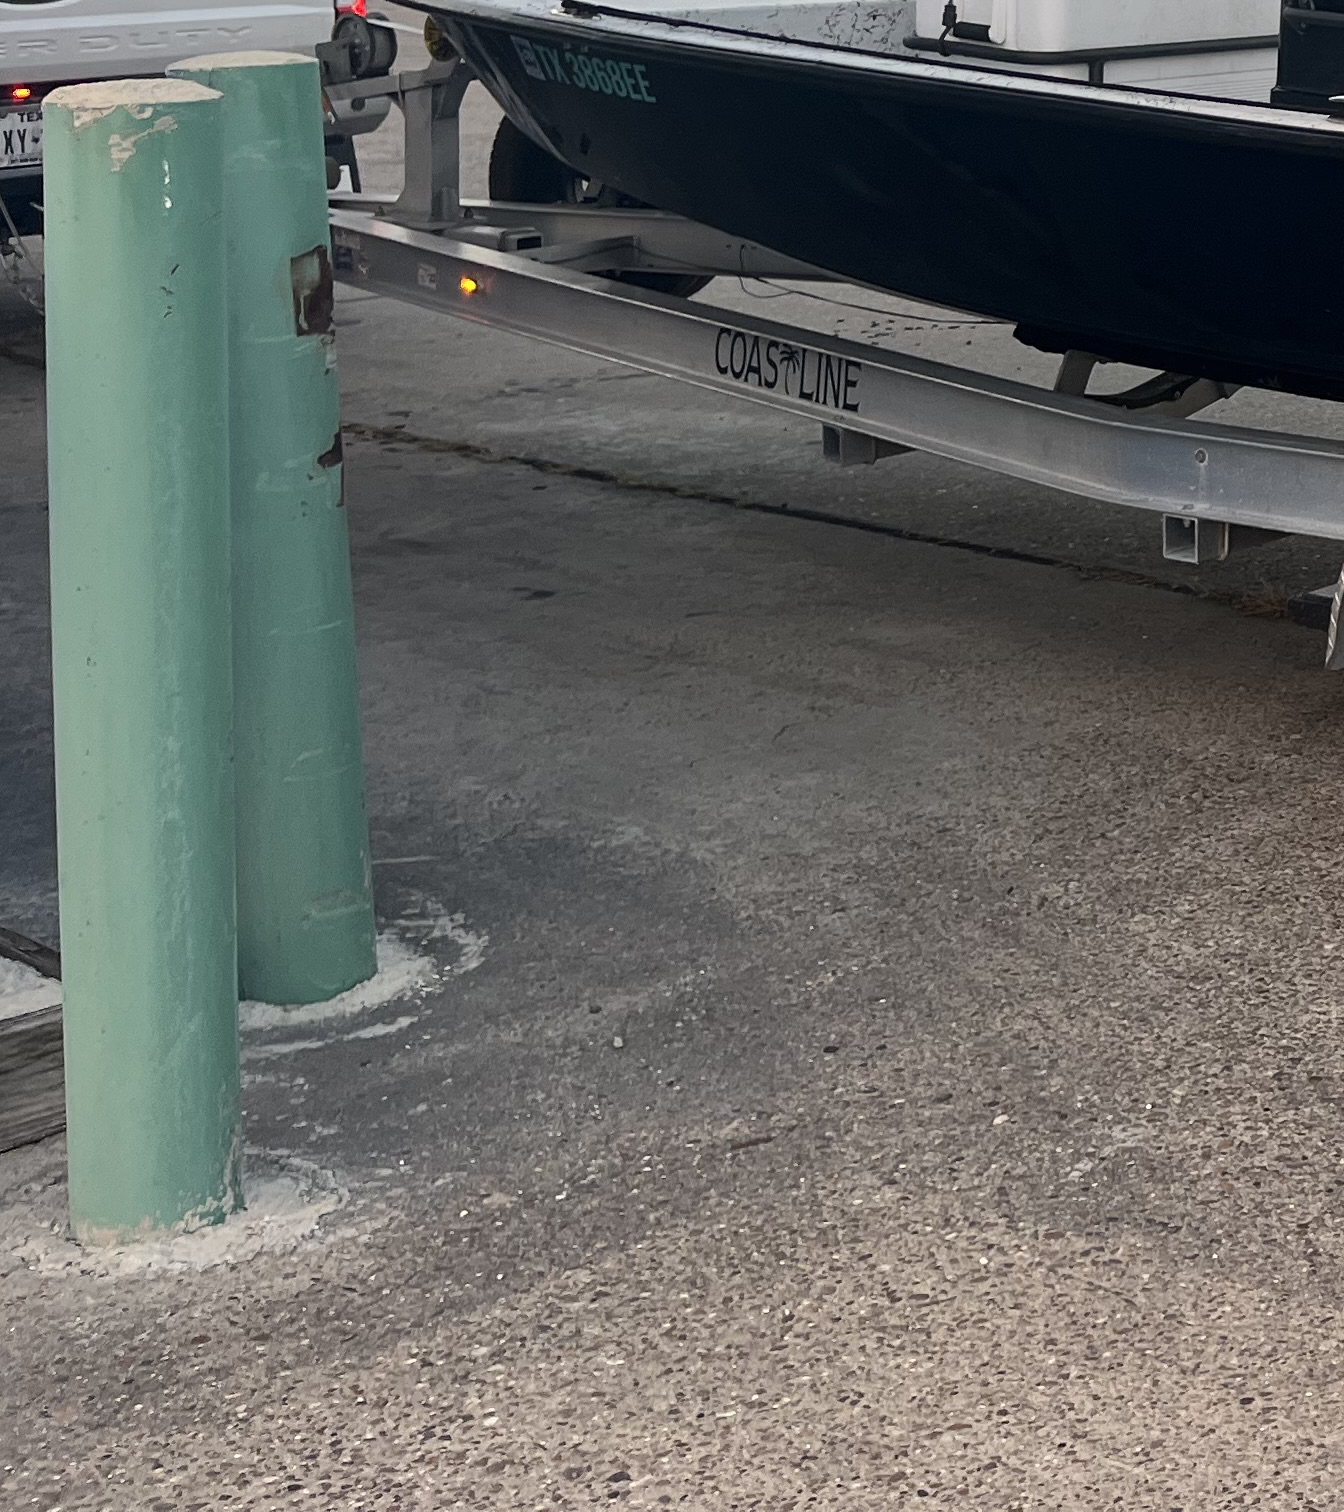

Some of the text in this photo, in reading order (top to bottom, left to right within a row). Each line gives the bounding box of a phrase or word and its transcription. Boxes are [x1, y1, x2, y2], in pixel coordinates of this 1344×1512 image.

[79, 25, 252, 54] DUTY
[532, 43, 571, 85] TX
[565, 52, 657, 103] 3868EE
[18, 111, 43, 123] TEX
